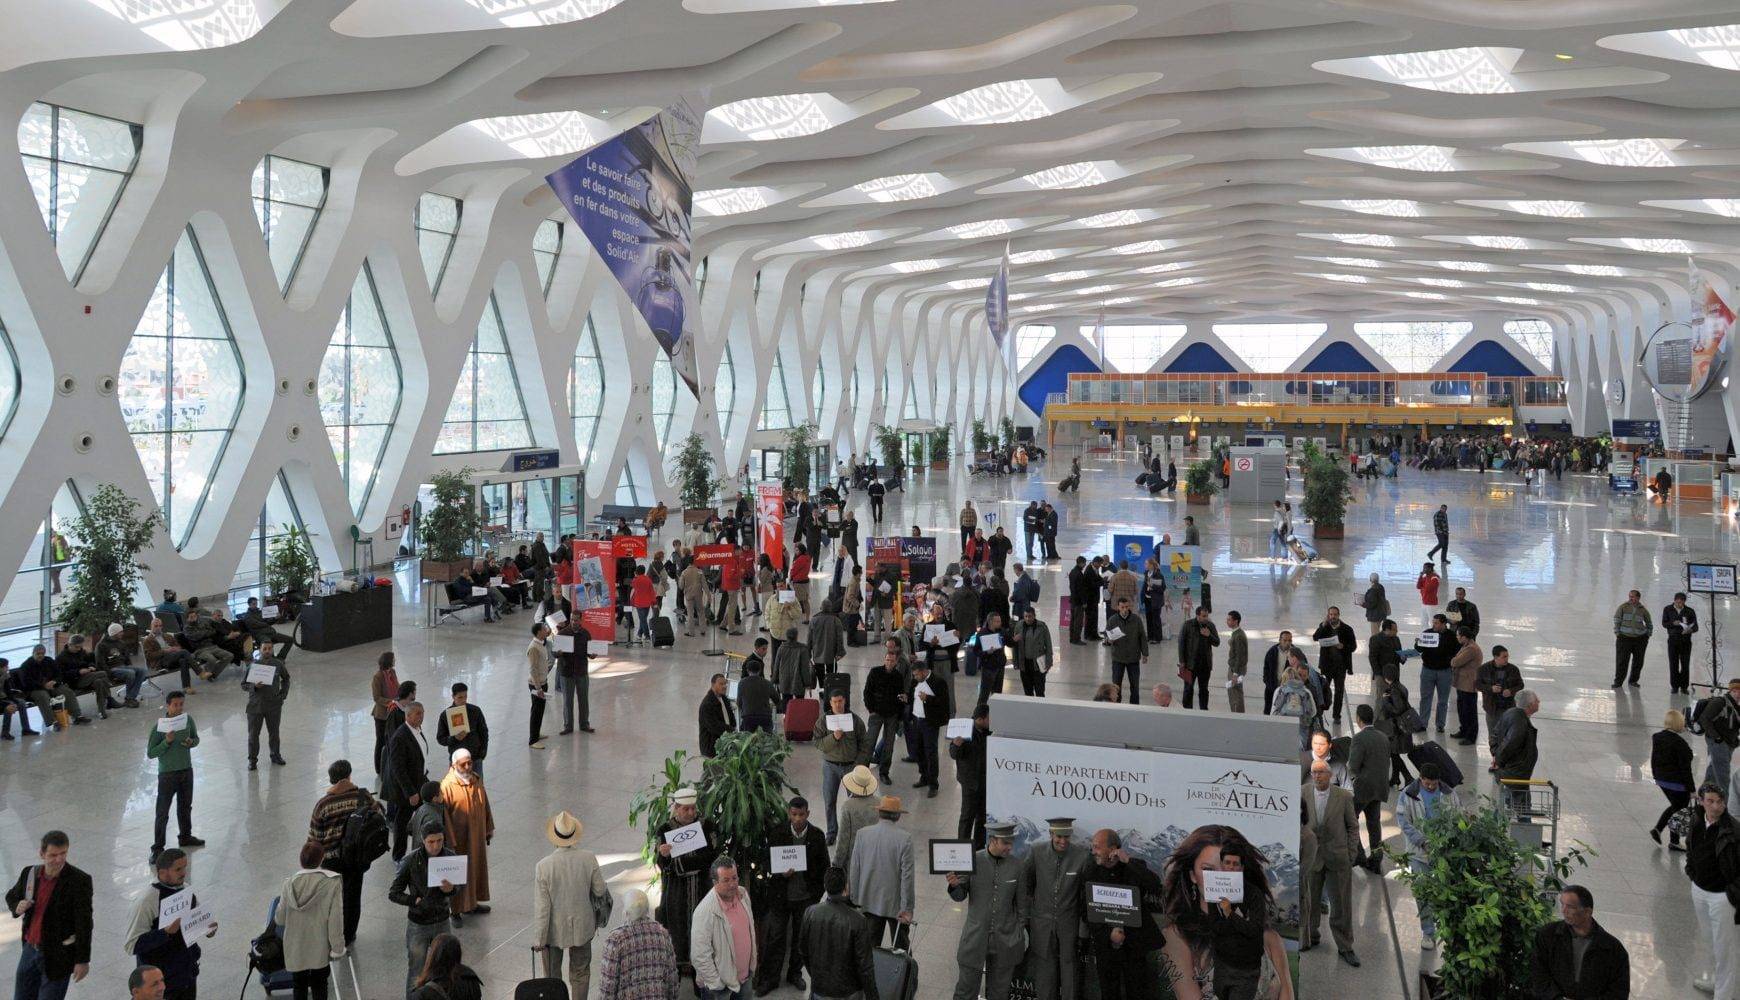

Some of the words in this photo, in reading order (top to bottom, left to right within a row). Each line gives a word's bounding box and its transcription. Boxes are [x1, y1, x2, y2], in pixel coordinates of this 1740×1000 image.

[587, 157, 597, 171] Le
[599, 165, 623, 183] savoir
[624, 173, 641, 191] faire
[582, 178, 591, 190] et
[593, 182, 607, 196] des
[609, 189, 640, 209] produits
[574, 195, 585, 207] en
[586, 197, 598, 210] fer
[600, 203, 619, 219] dans
[621, 213, 640, 228] votre
[612, 229, 640, 245] espace
[697, 551, 732, 561] Marmara
[995, 758, 1041, 774] VOTRE
[1046, 764, 1149, 784] APPARTEMENT
[1032, 777, 1045, 797] À
[1051, 780, 1131, 805] 100.000
[1187, 789, 1226, 801] JARDINS
[1225, 788, 1289, 812] ATLAS
